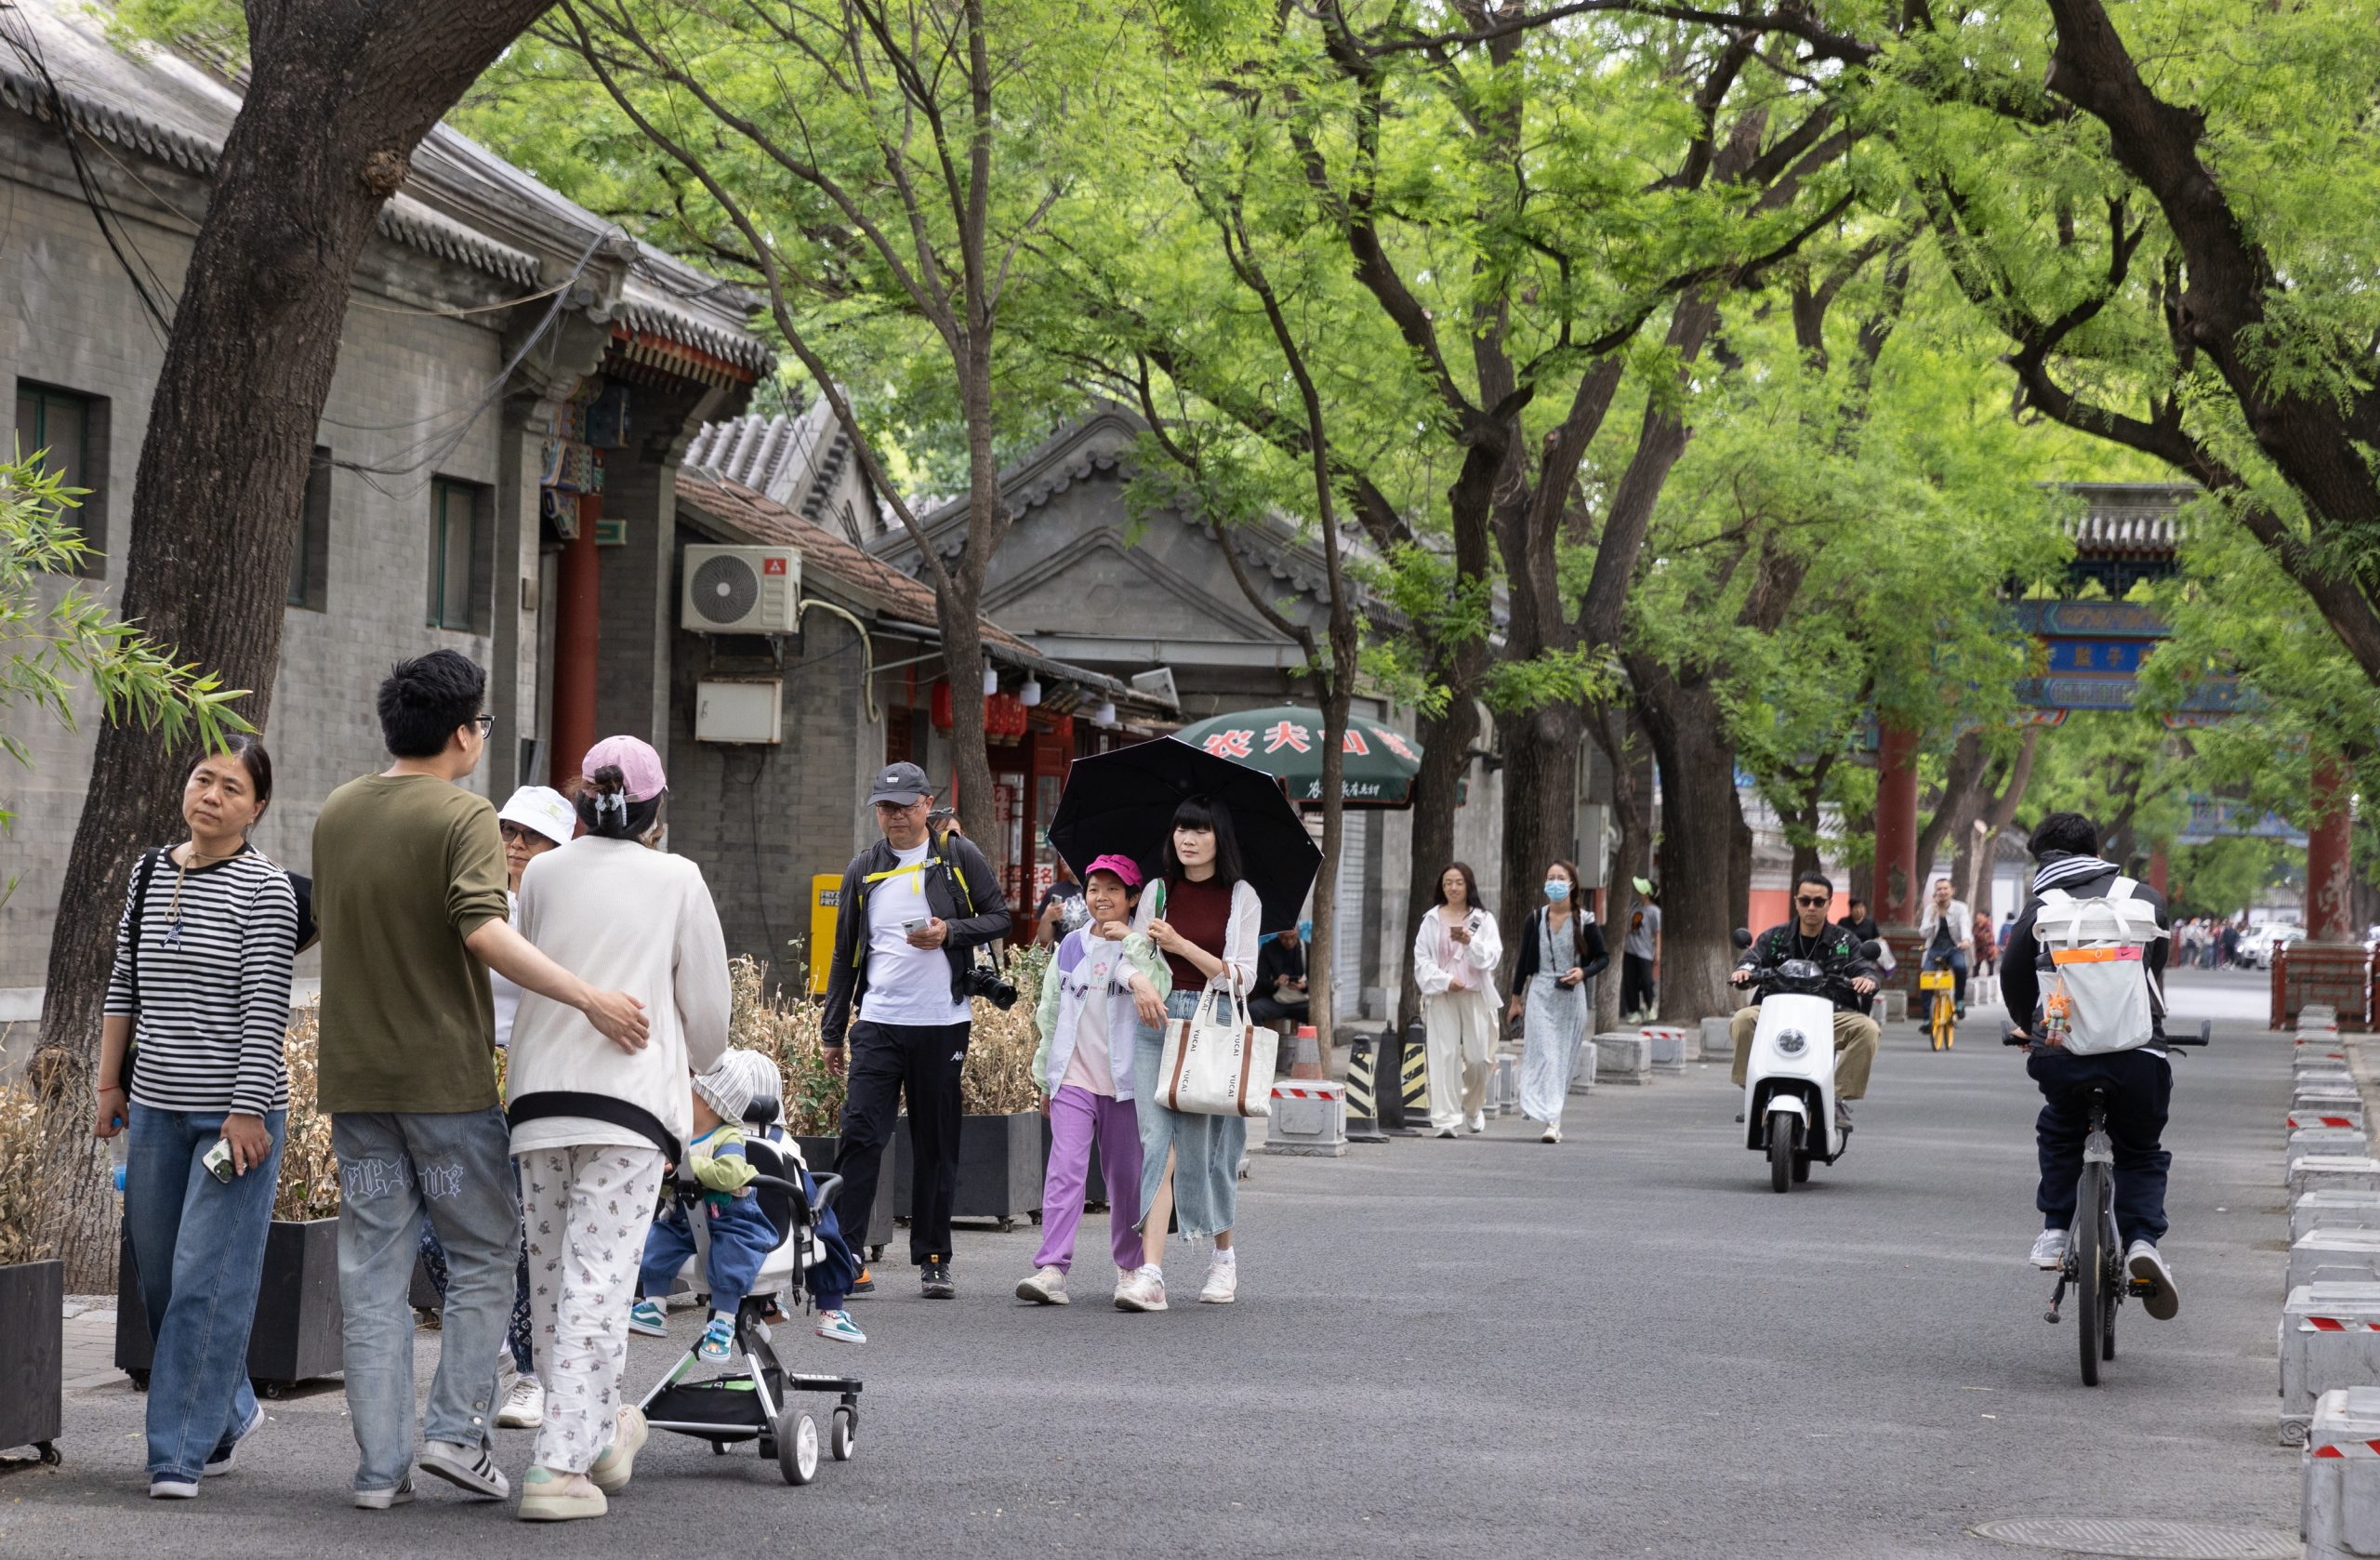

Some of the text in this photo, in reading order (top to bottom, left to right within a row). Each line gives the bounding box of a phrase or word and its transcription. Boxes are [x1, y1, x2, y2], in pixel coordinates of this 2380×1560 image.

[1190, 1029, 1200, 1052] YUCAI
[1233, 1034, 1241, 1057] YUCAI
[1181, 1069, 1191, 1092] YUCAI
[1227, 1074, 1237, 1098] YUCAI
